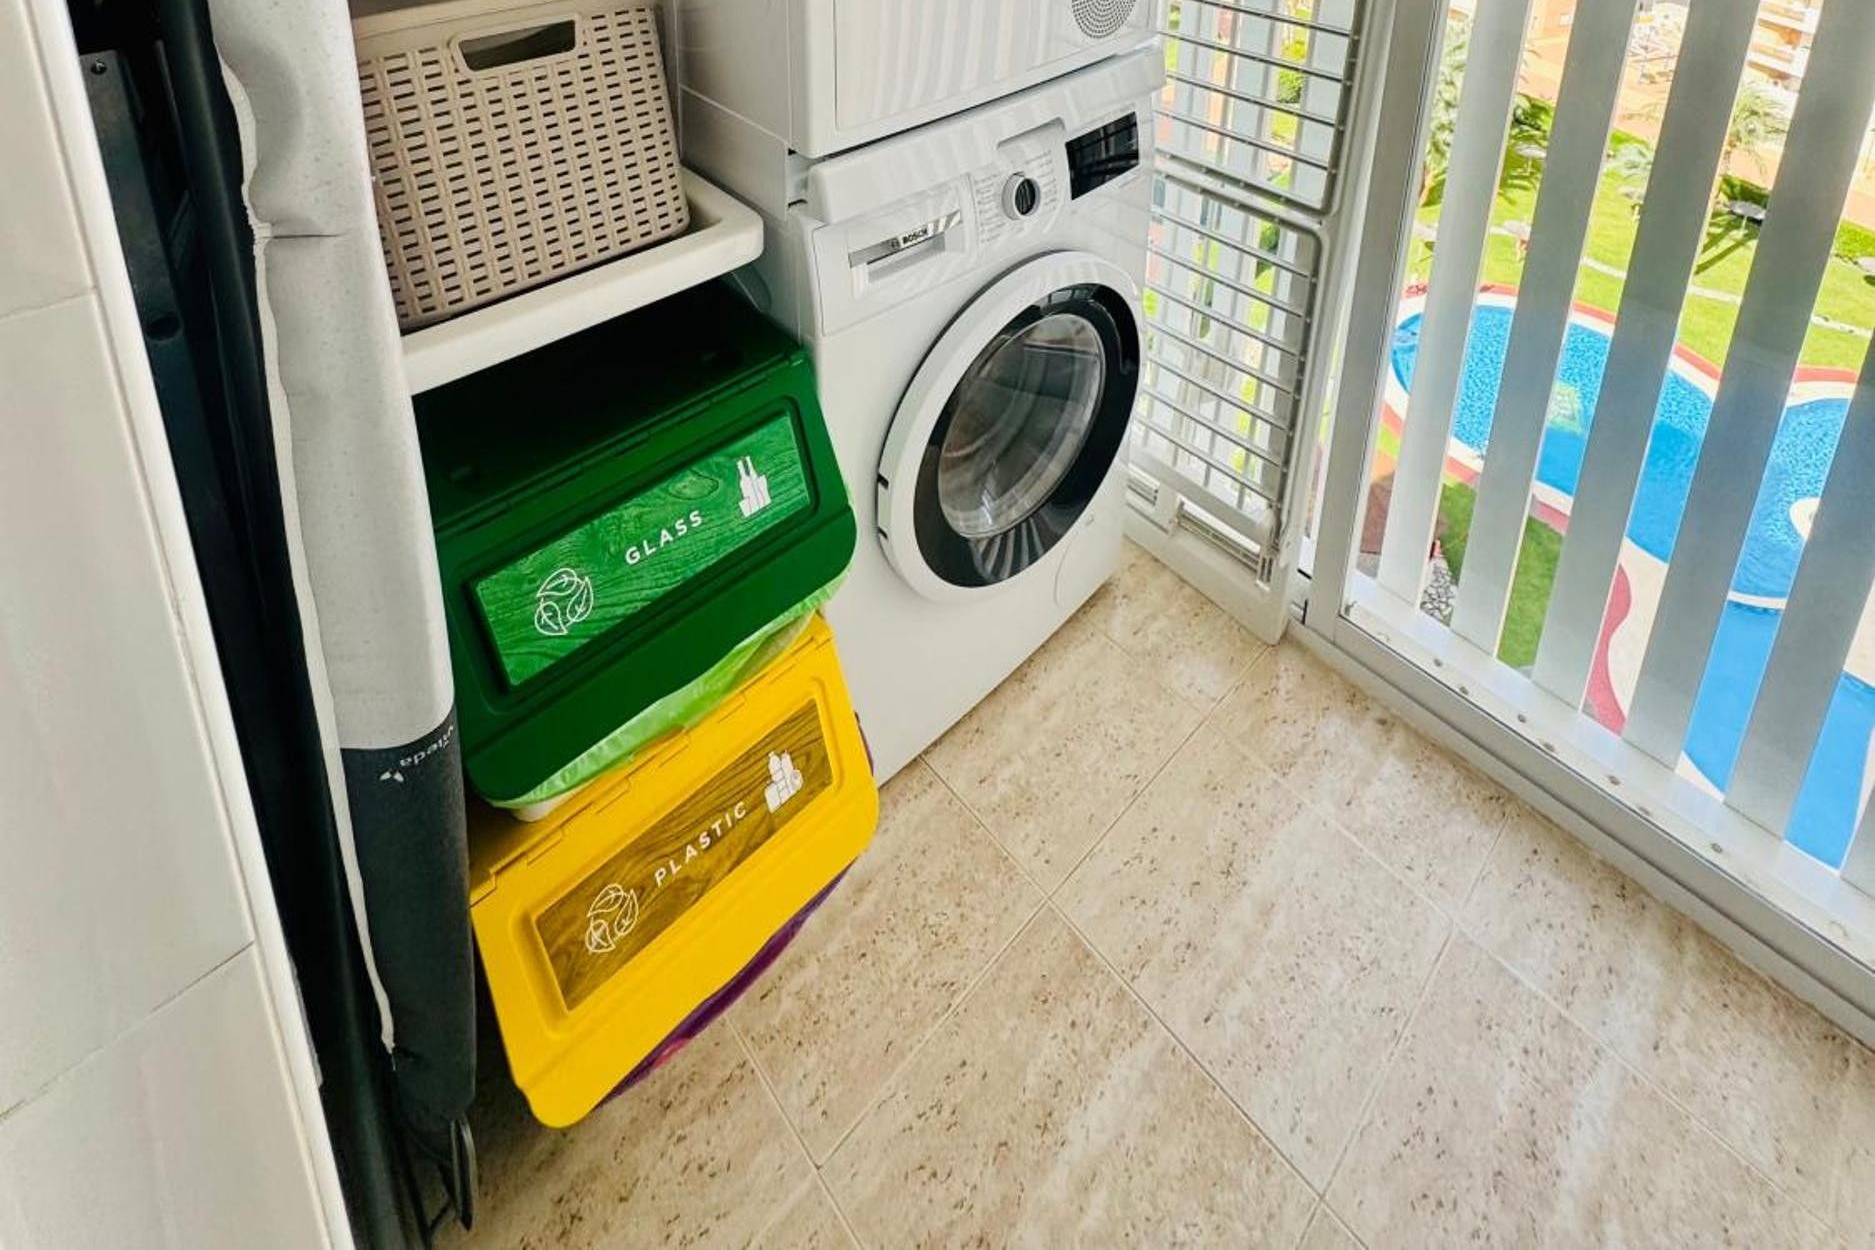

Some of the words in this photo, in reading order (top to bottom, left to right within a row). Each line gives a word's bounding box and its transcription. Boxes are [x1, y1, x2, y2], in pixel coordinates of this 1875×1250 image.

[902, 228, 928, 244] BOSCH
[625, 510, 703, 565] GLASS
[654, 801, 747, 887] PLASTIC
